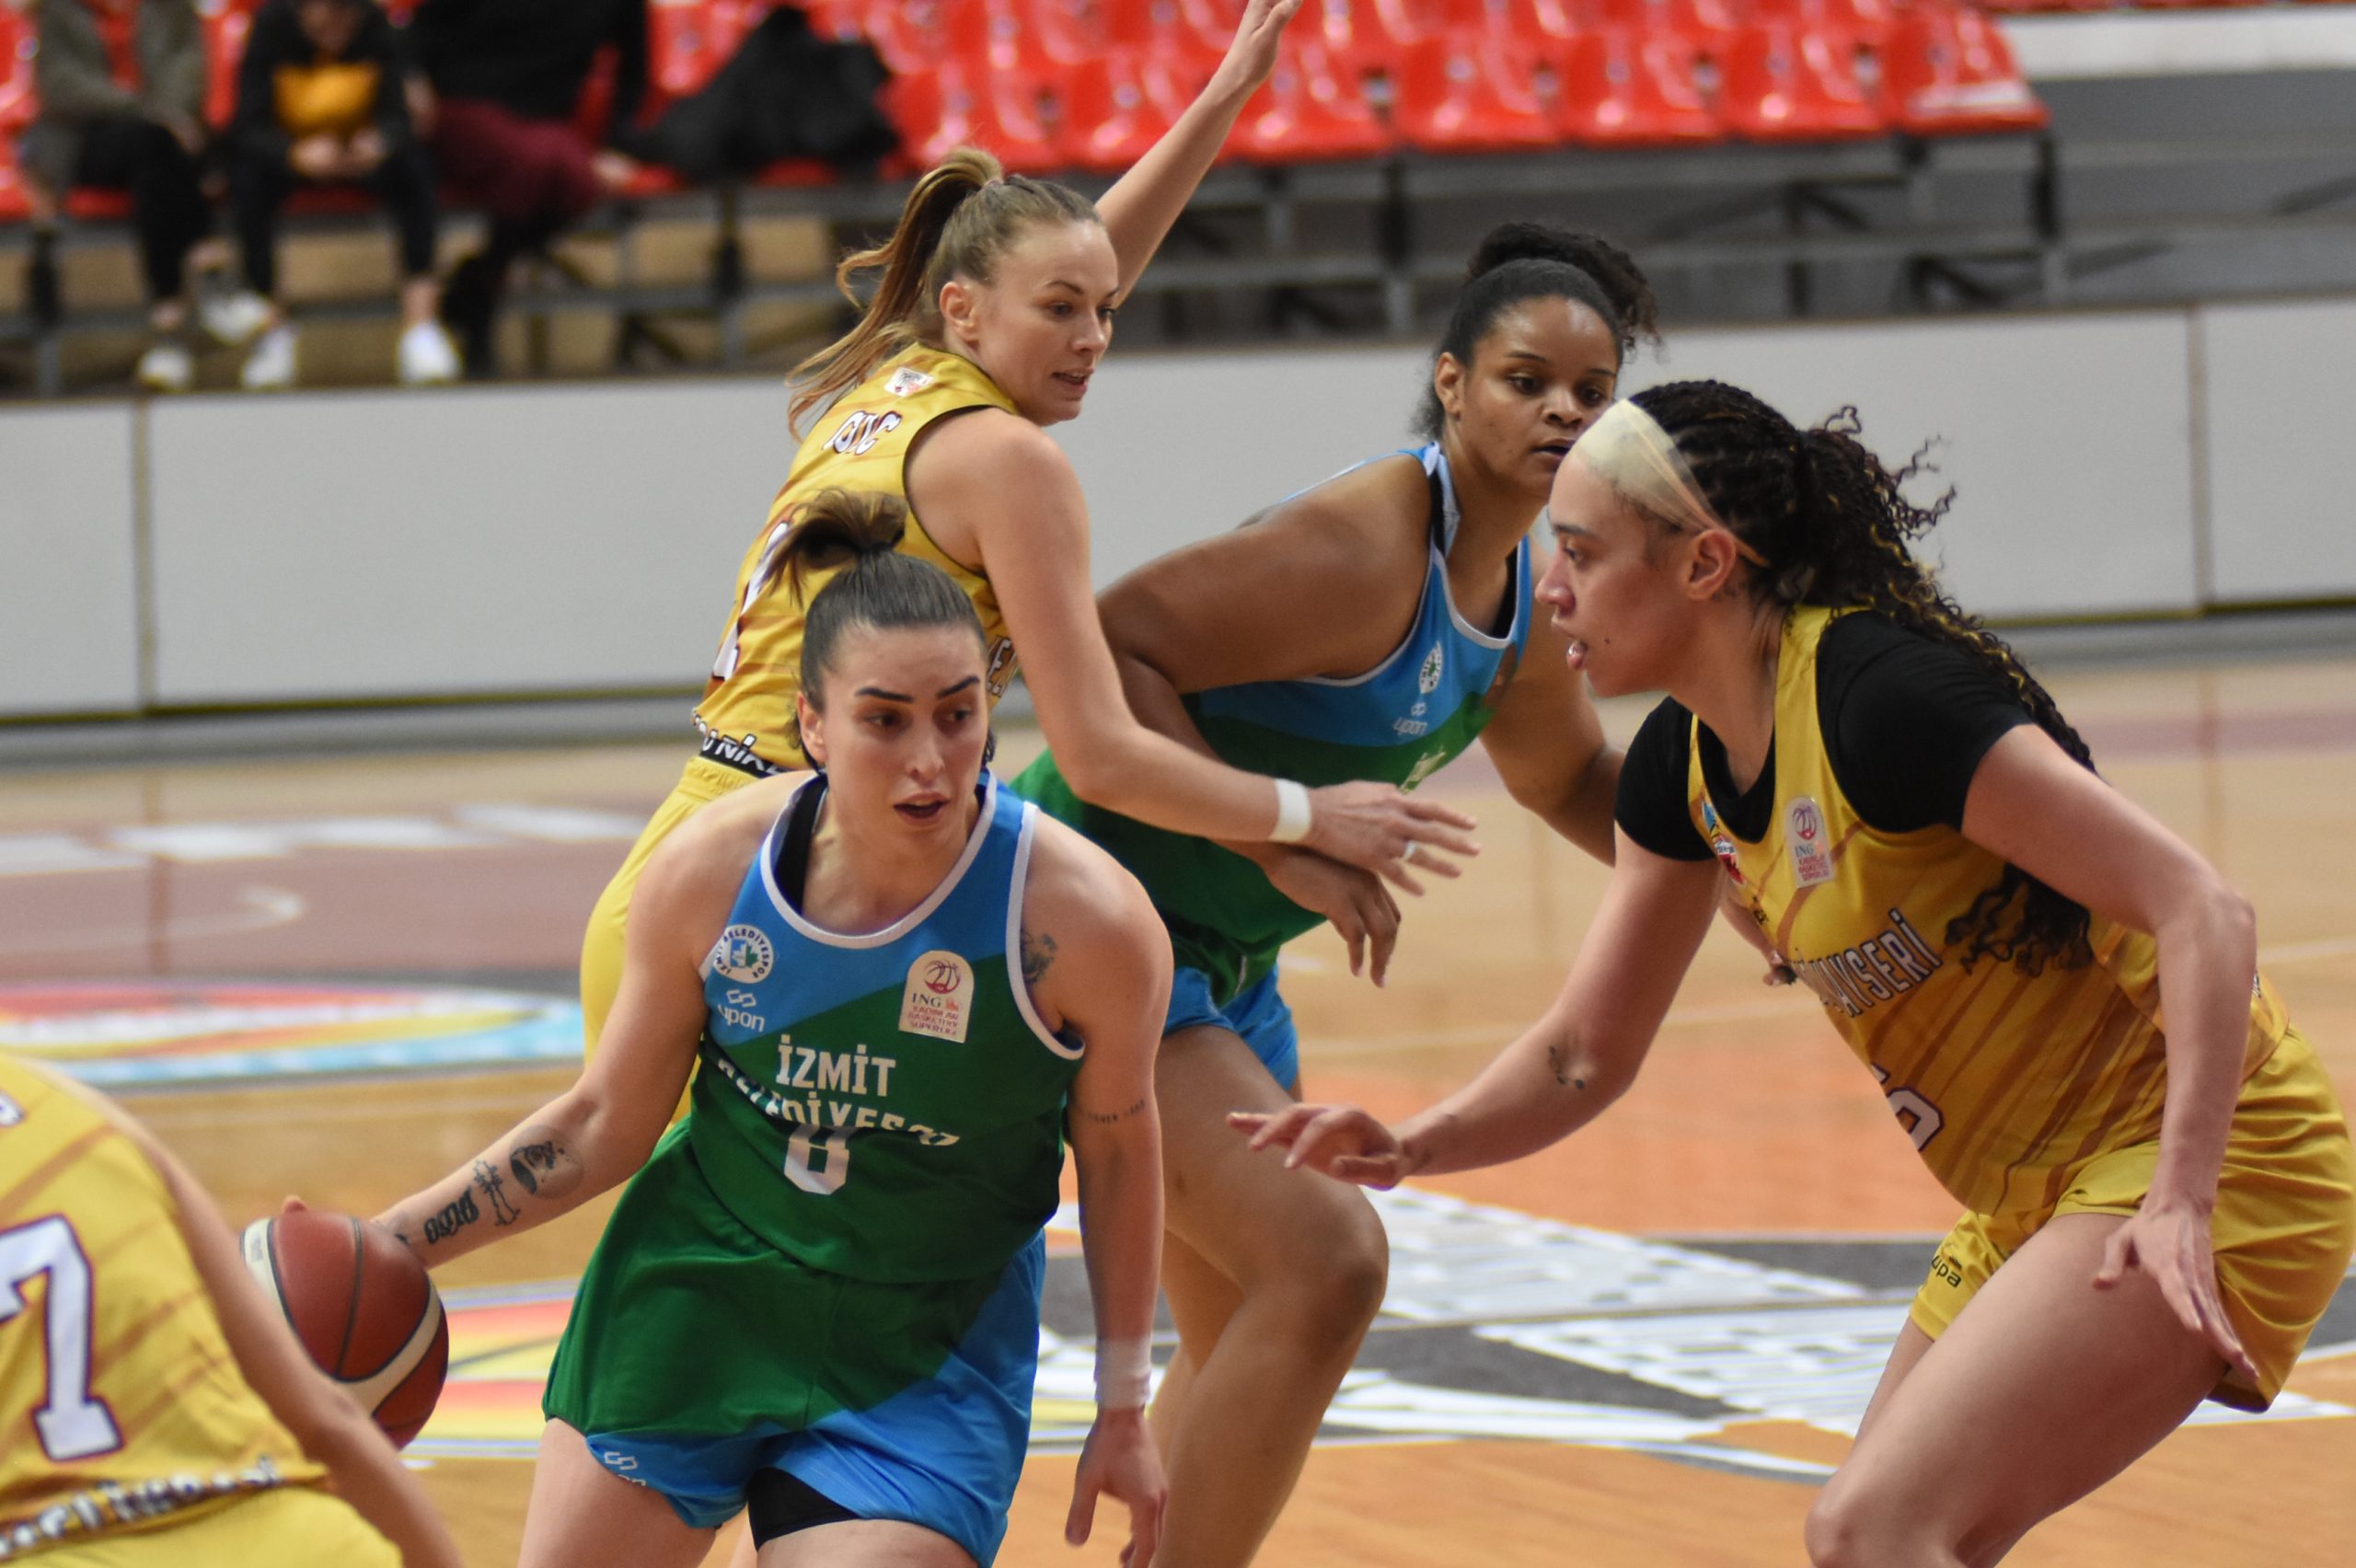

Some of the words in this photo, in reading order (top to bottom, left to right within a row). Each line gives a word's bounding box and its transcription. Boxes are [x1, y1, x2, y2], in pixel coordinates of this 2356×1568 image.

[1799, 906, 1944, 1017] AYSERİ
[912, 993, 942, 1008] ING
[775, 1033, 896, 1097] İZMİT
